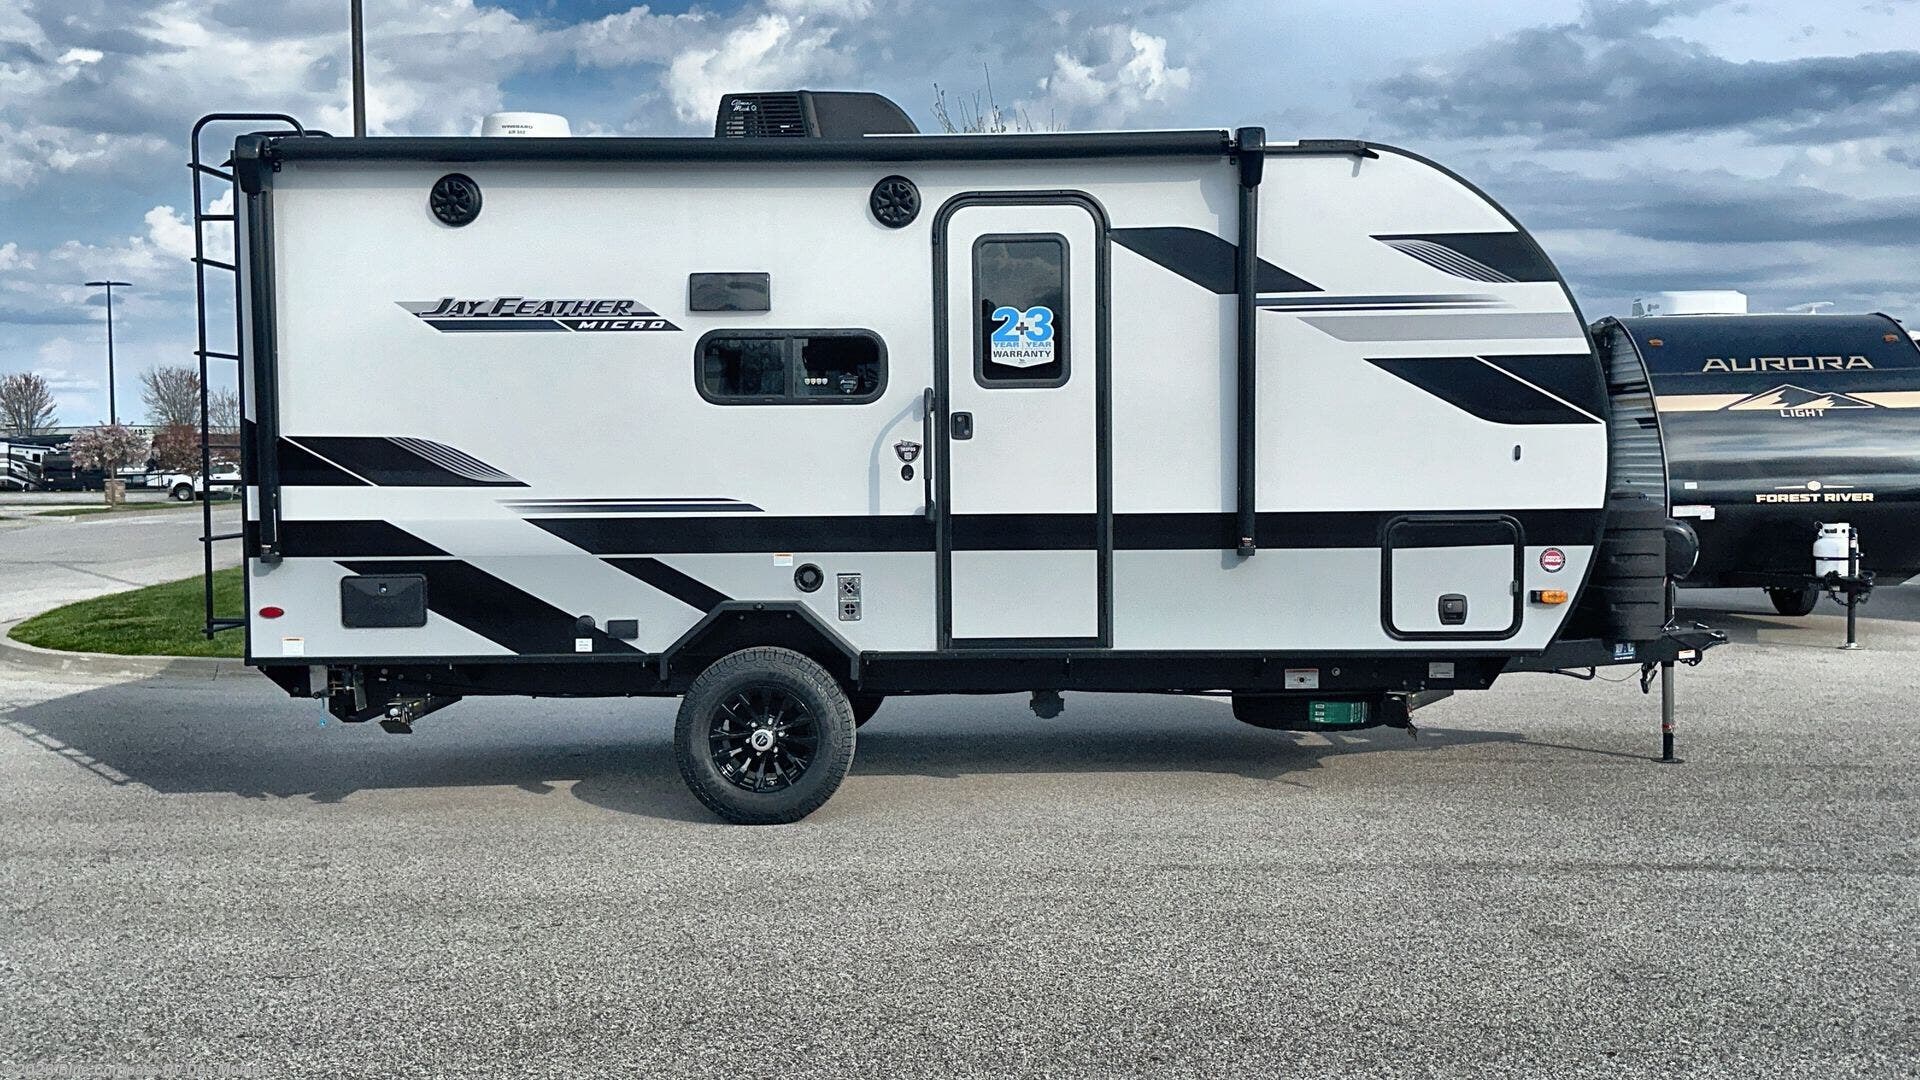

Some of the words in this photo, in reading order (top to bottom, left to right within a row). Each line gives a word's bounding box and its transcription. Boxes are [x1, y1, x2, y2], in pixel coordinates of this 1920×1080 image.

[577, 320, 667, 330] MICRO
[993, 350, 1052, 358] WARRANTY
[1702, 355, 1875, 373] AURORA
[1779, 408, 1825, 418] LIGHT
[1755, 493, 1822, 503] FOREST
[1823, 492, 1875, 503] RIVER
